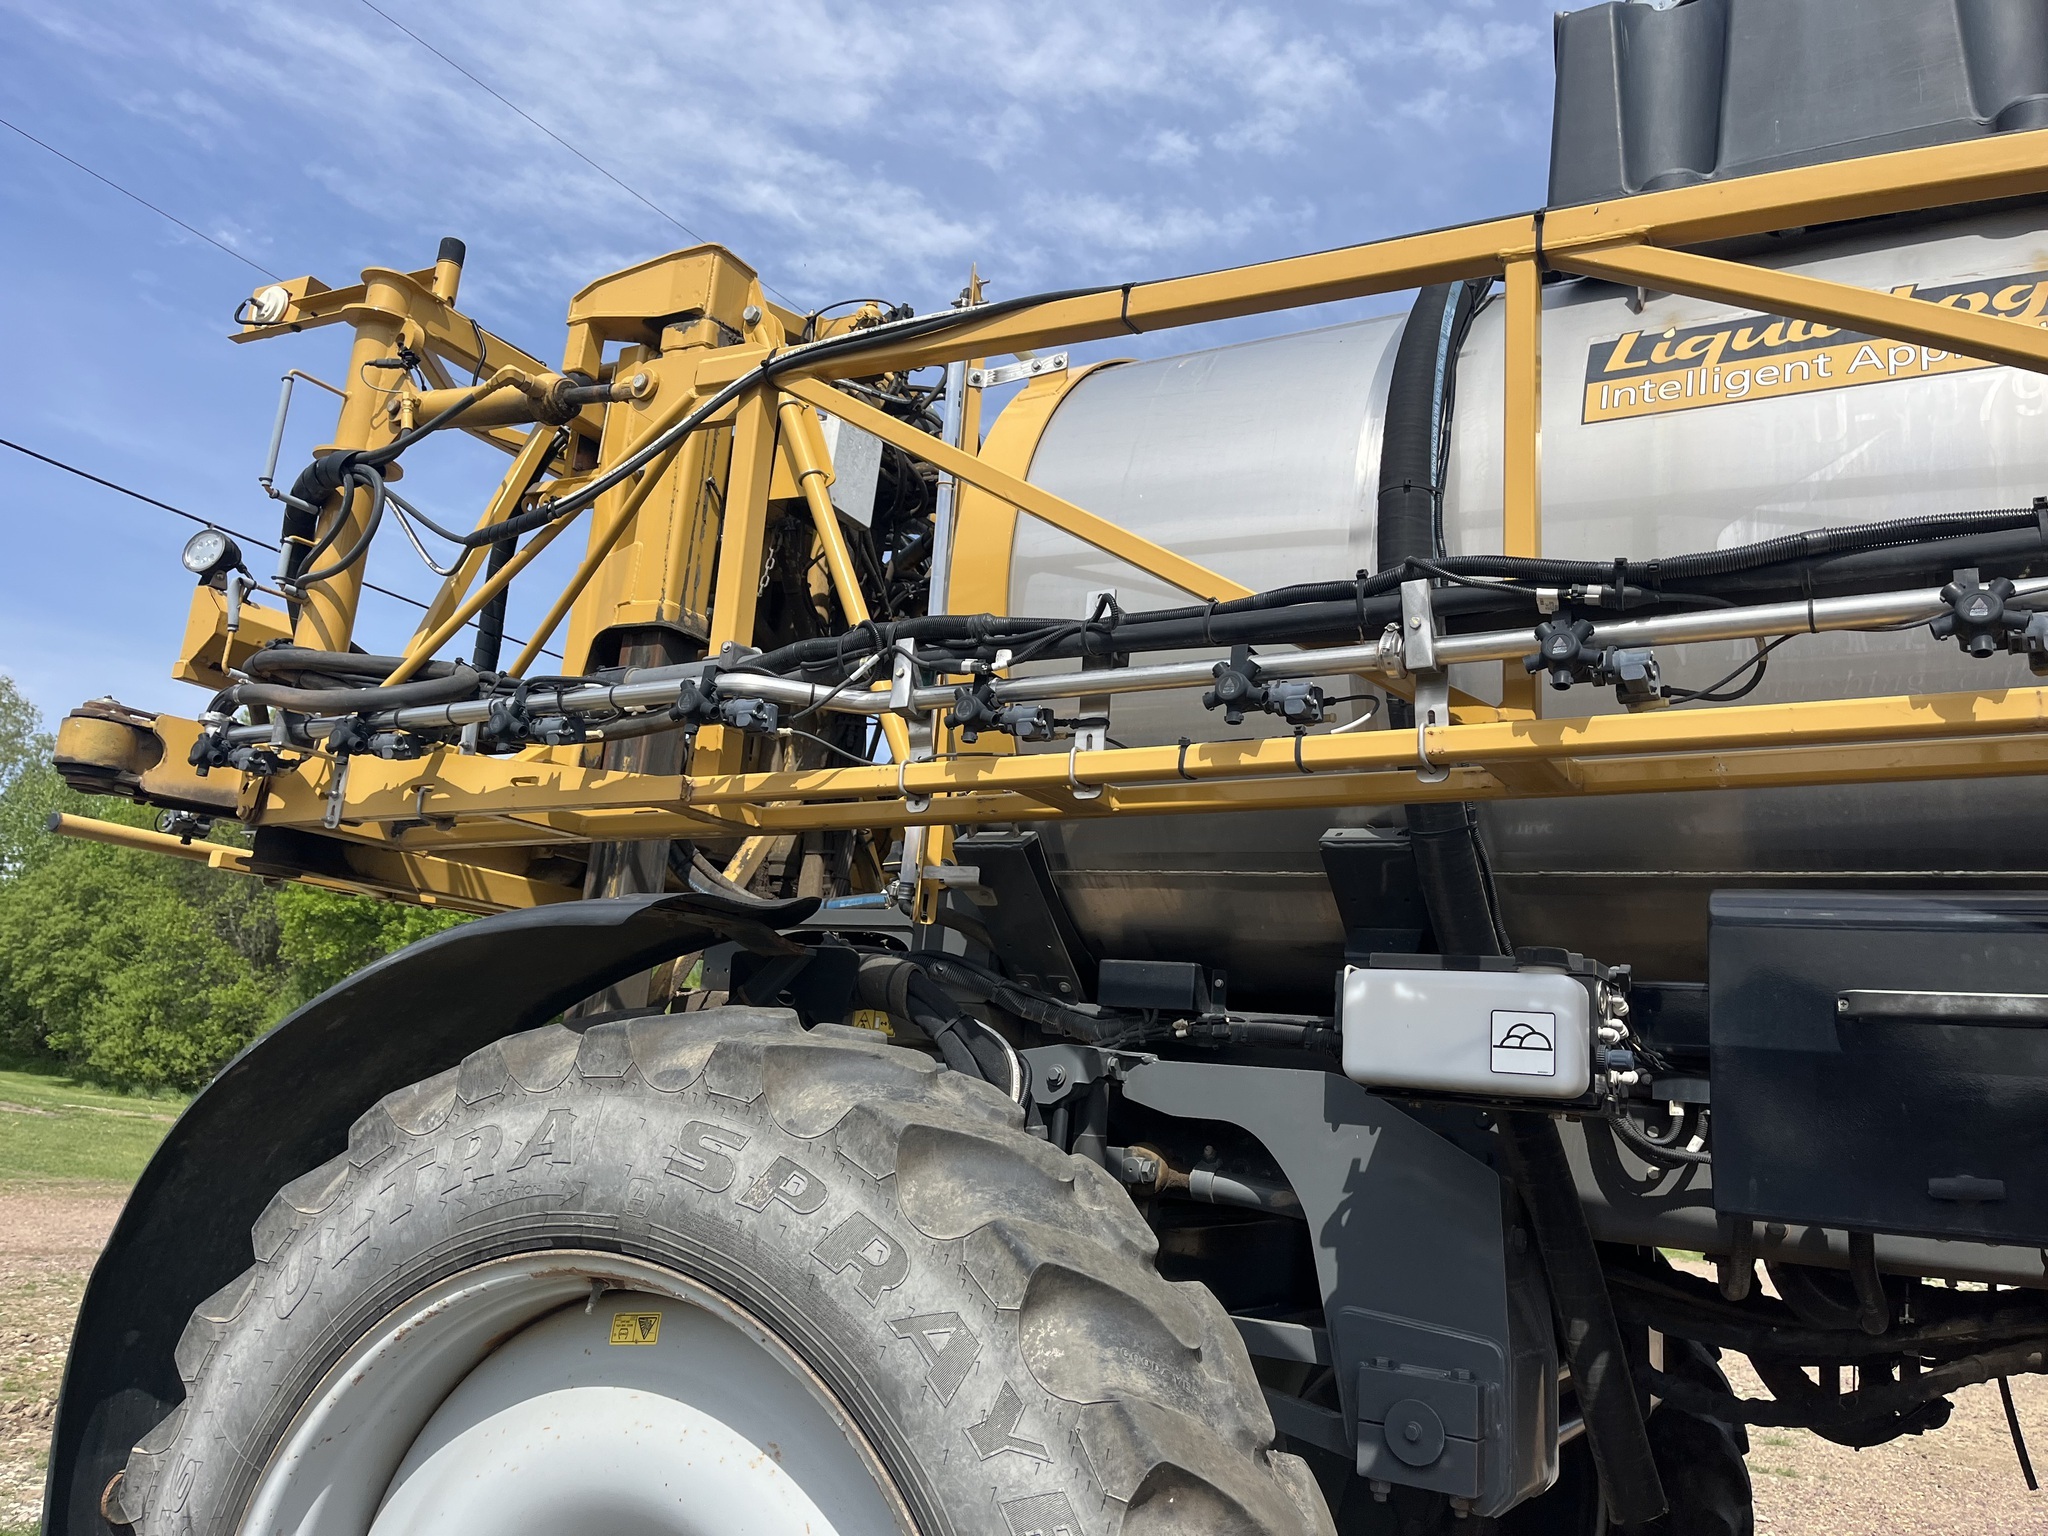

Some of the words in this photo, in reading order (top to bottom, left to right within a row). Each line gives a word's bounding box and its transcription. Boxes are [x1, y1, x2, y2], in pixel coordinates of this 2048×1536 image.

[1600, 352, 1832, 411] Intelligent
[1846, 344, 1964, 376] App
[274, 1108, 576, 1321] ULTRA
